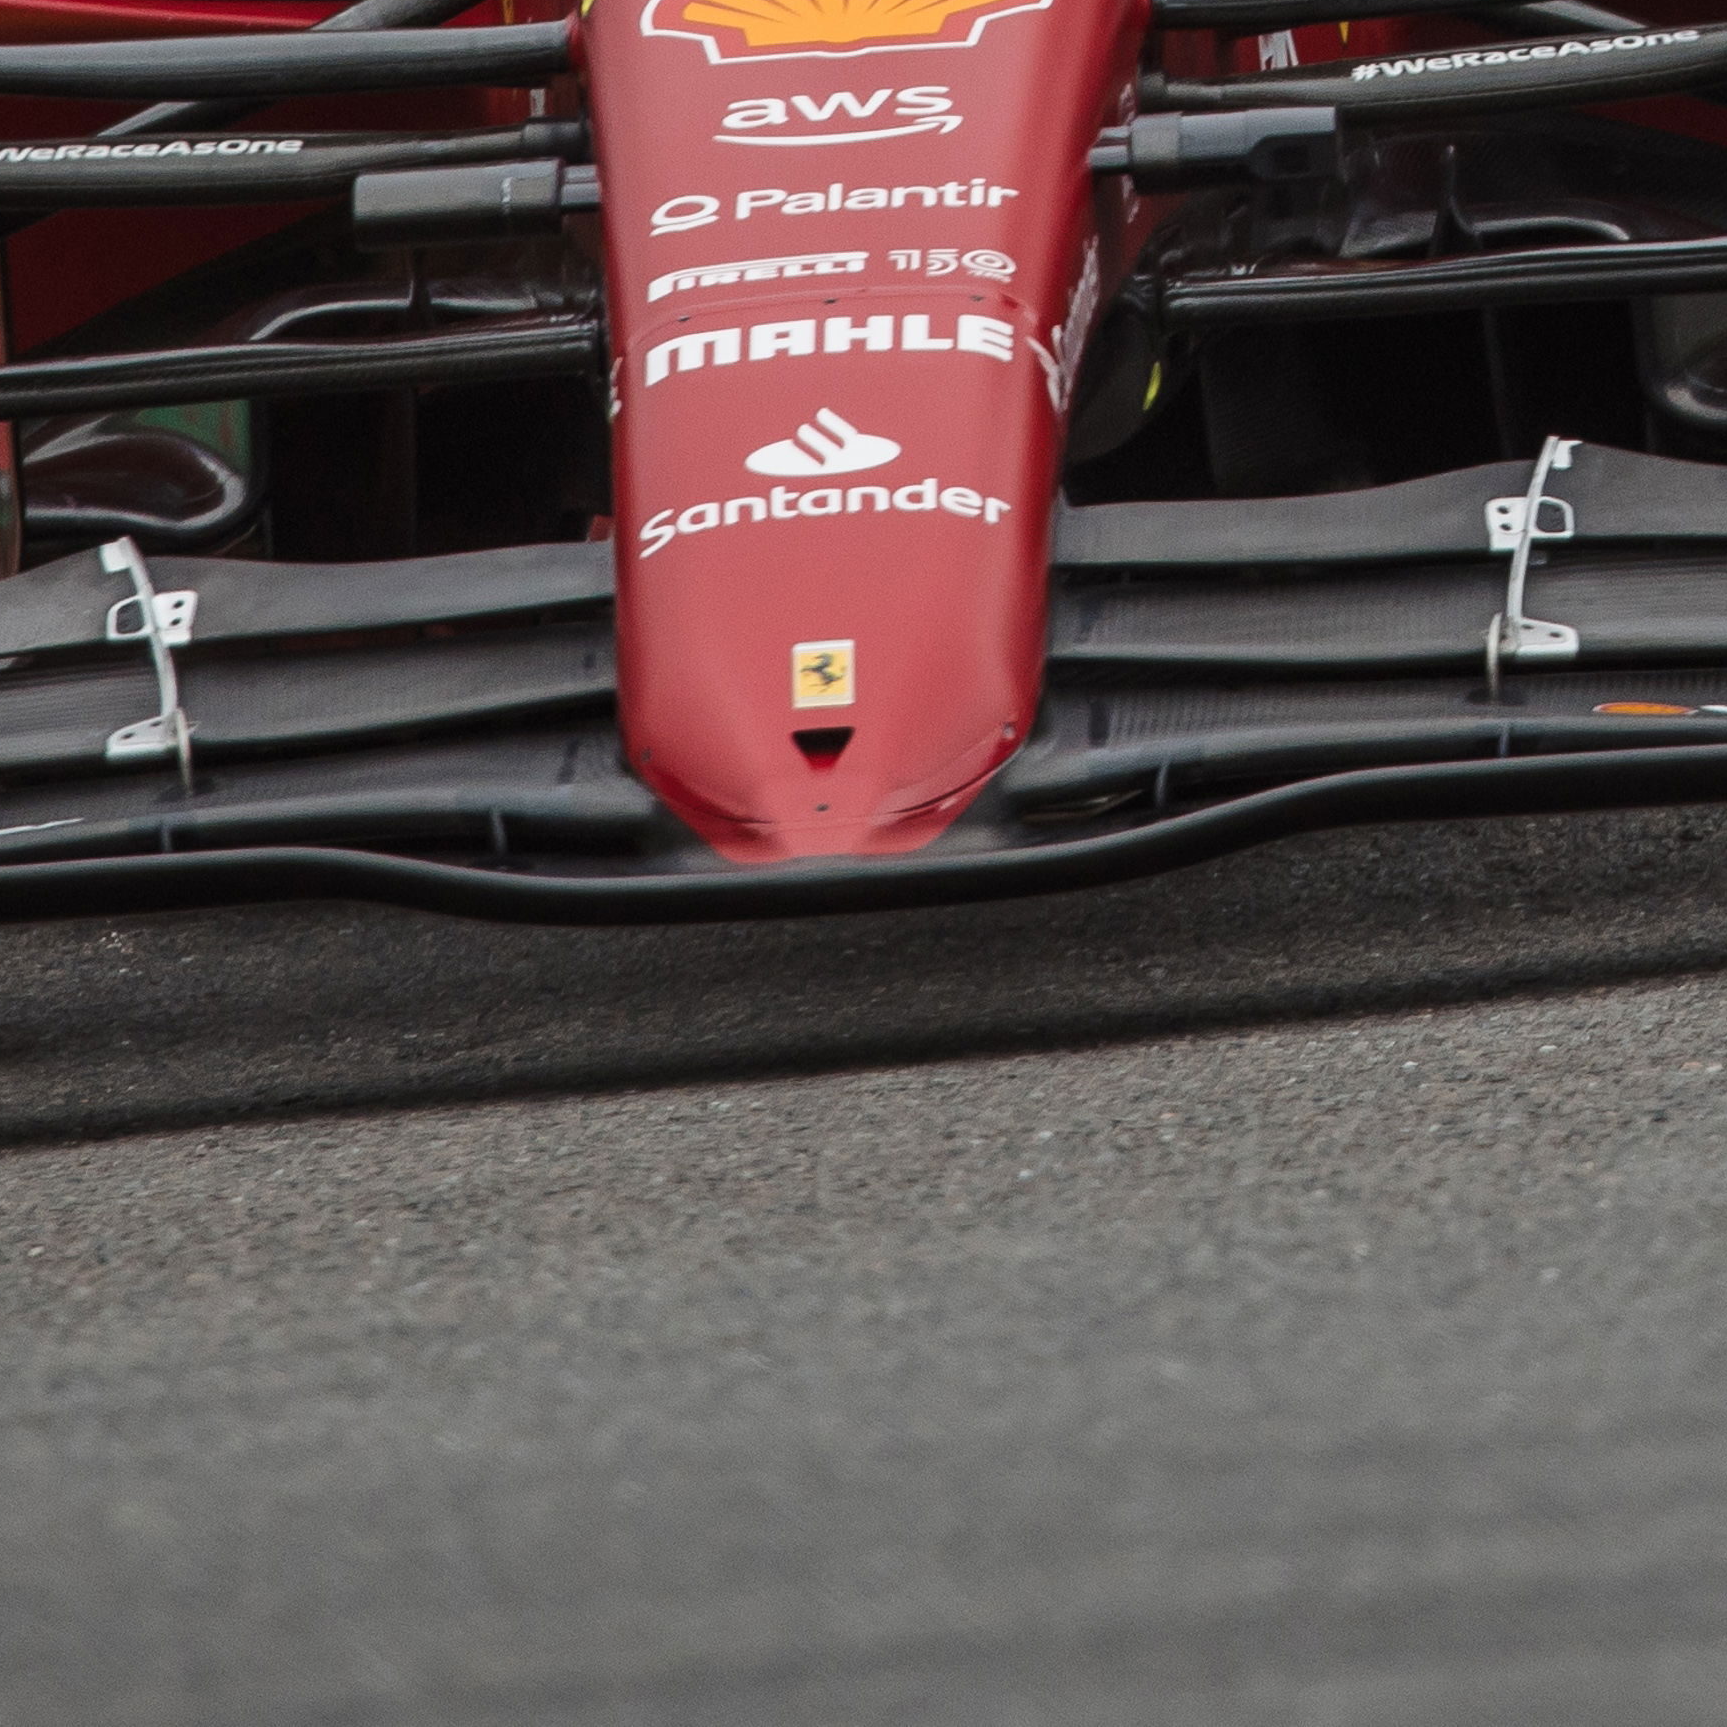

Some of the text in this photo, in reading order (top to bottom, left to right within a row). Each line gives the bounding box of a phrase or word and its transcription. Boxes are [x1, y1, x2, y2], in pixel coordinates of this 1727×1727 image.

[1351, 29, 1701, 81] #WeRaceAsOne
[722, 85, 953, 129] aws
[734, 178, 1019, 221] Palantir
[647, 251, 870, 303] PIRELLI
[644, 313, 1015, 388] MAHLE
[639, 478, 1011, 558] Santander
